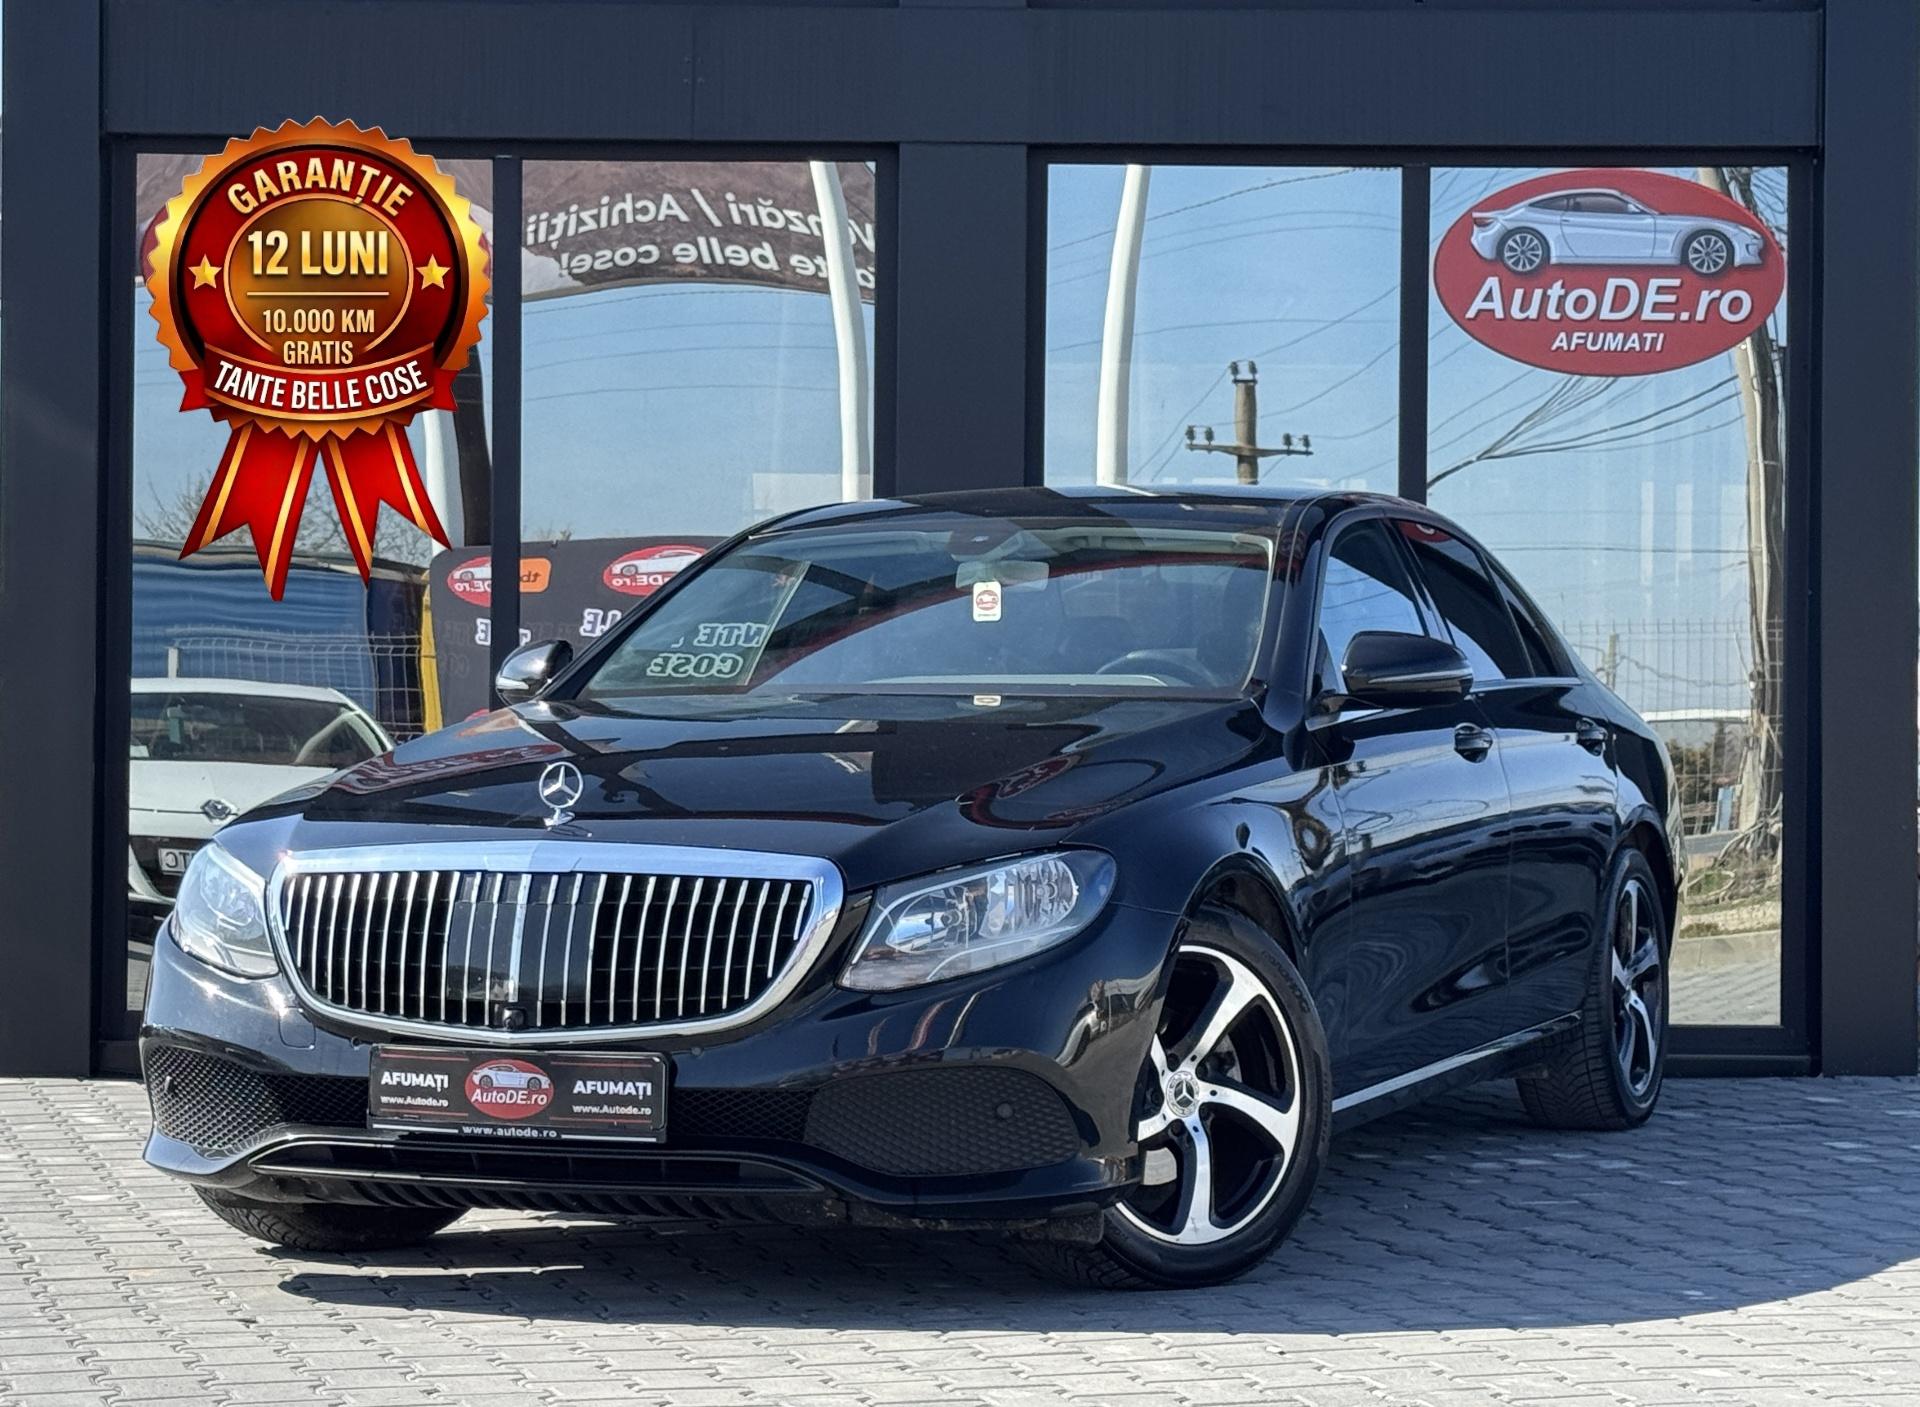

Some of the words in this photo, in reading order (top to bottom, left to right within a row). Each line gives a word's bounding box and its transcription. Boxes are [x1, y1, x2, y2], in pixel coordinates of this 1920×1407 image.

[1465, 276, 1752, 323] AutoDE.ro
[1551, 332, 1665, 351] AFUMATI
[381, 1071, 449, 1092] AFUMAȚI
[573, 1080, 652, 1100] AFUMAȚI
[380, 1095, 449, 1107] www.Autode.ro
[470, 1088, 548, 1106] AutoDE.ro
[572, 1104, 652, 1116] www.Autode.ro
[462, 1125, 557, 1138] www.autode.ro
